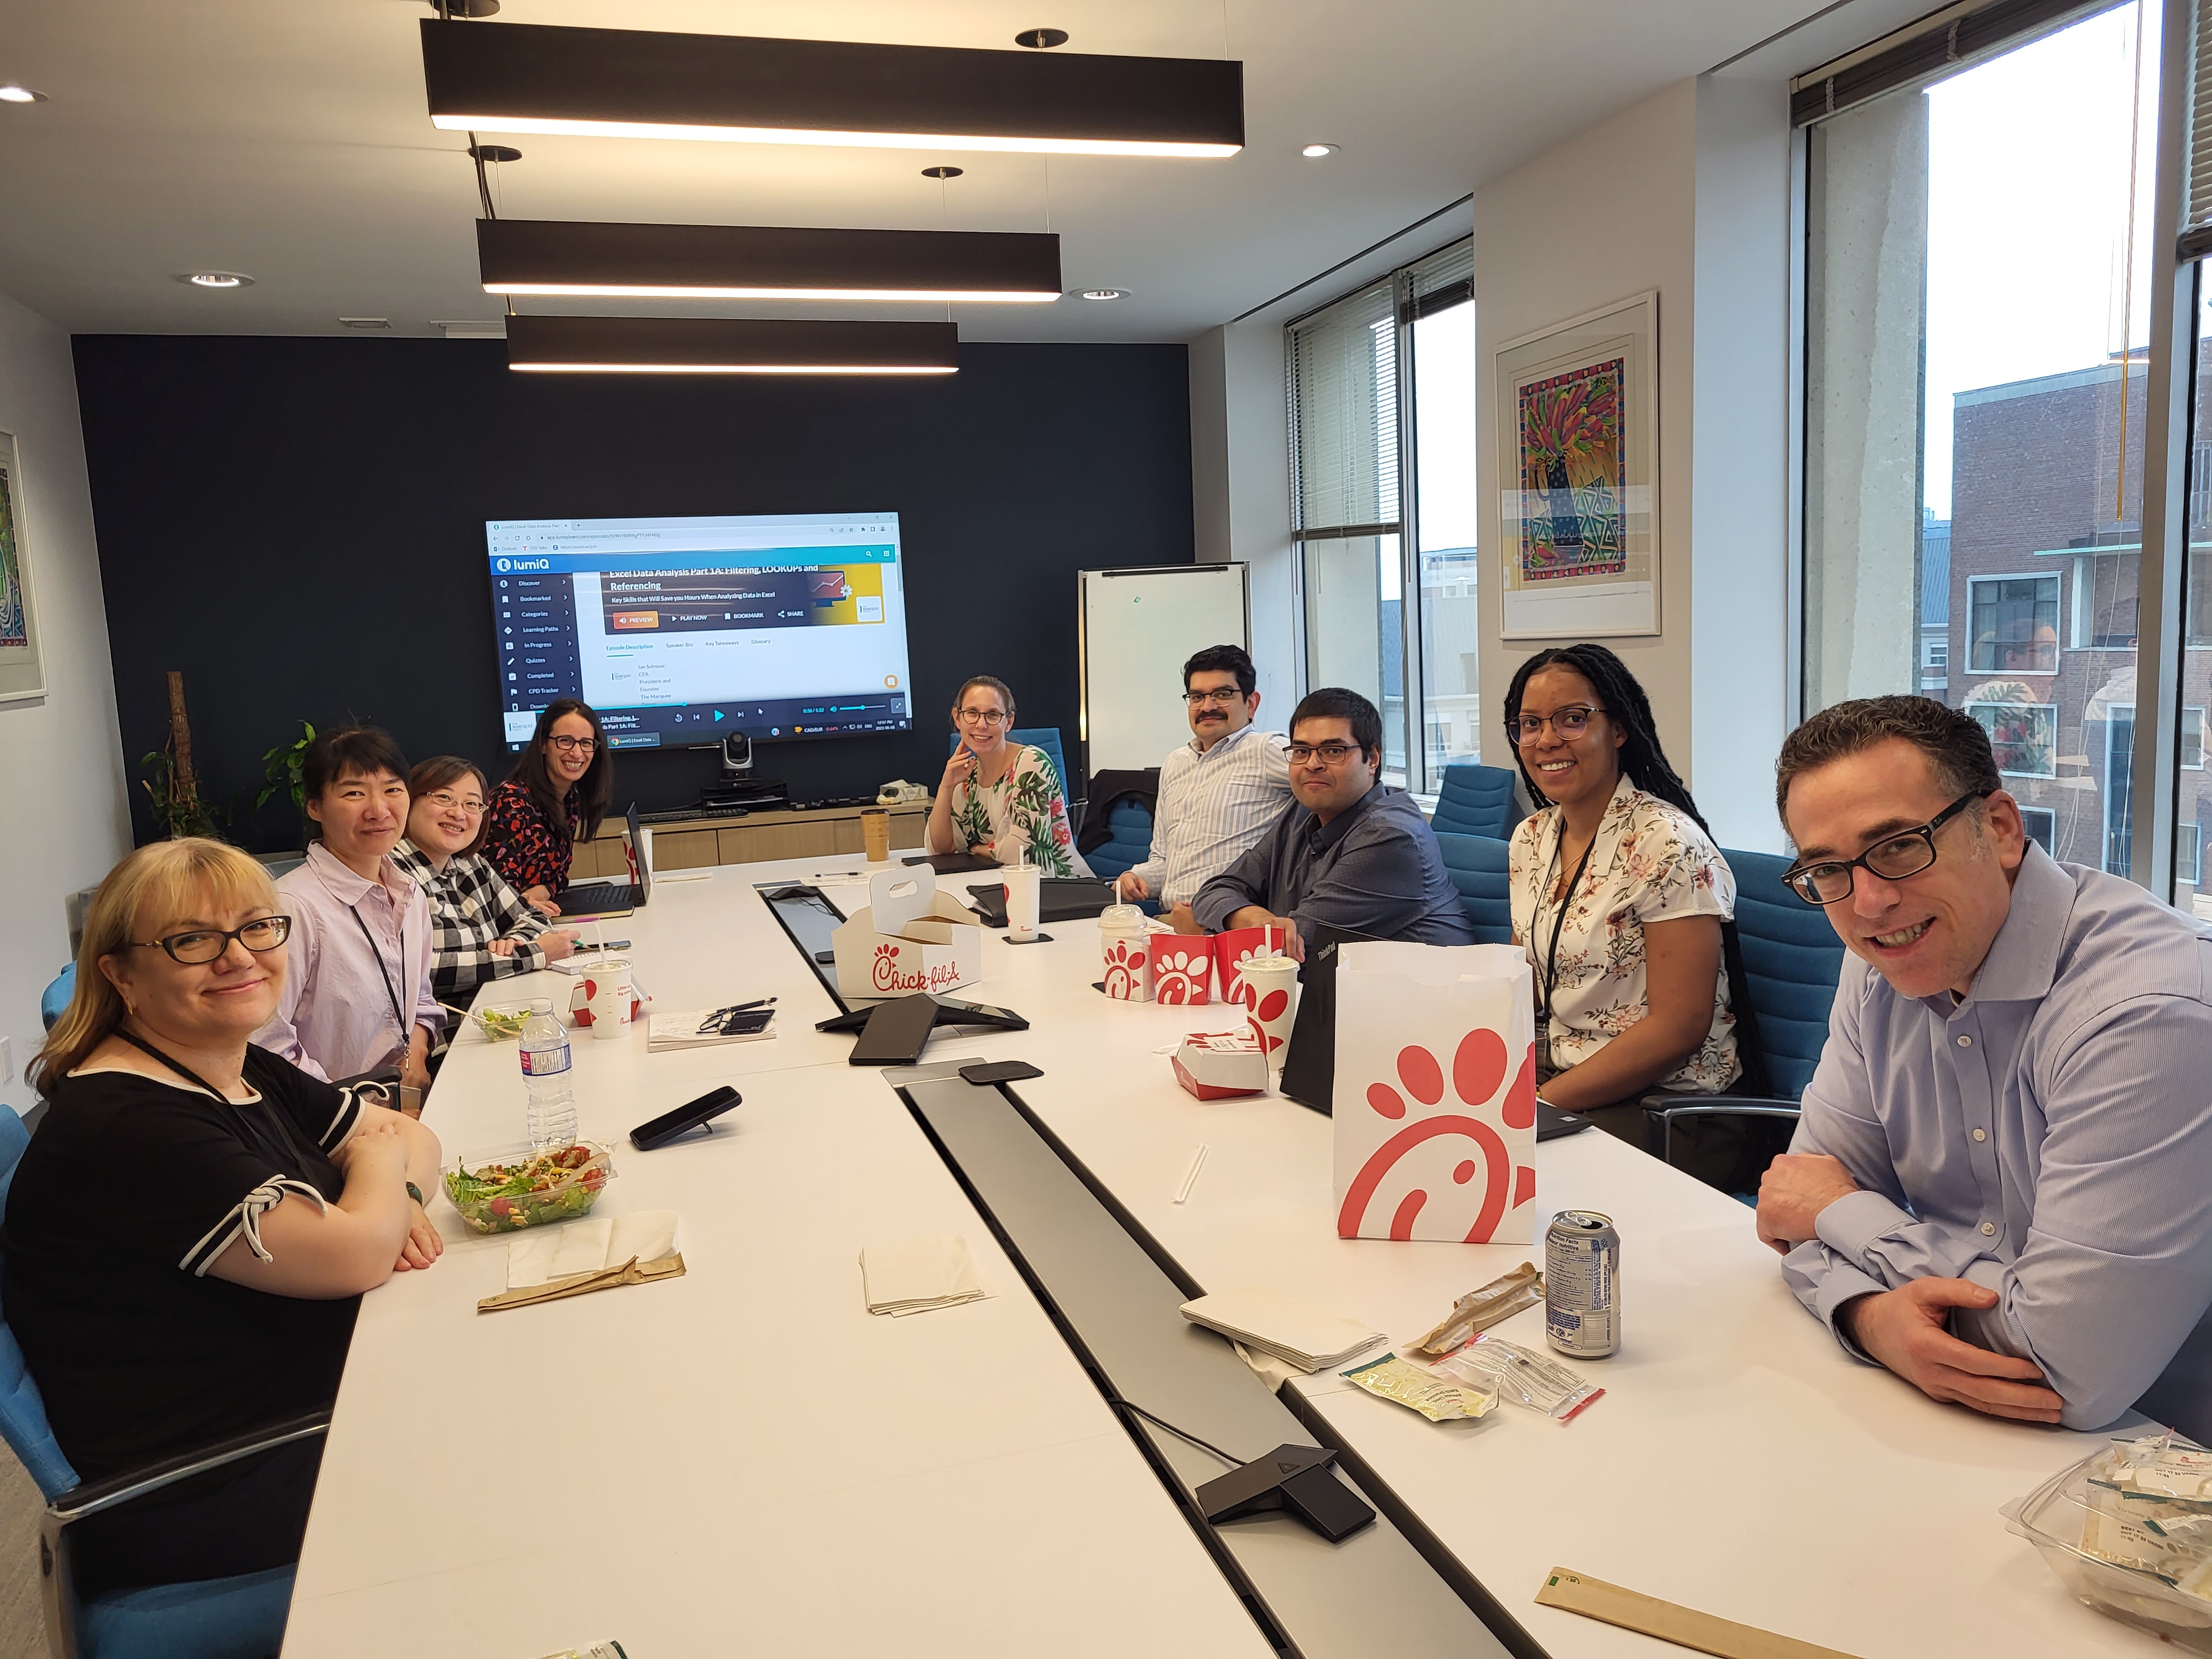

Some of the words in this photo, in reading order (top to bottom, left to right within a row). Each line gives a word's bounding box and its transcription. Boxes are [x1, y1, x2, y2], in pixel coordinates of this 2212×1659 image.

[513, 559, 550, 571] lumiQ
[655, 568, 690, 578] Analysis
[725, 566, 761, 575] Filtering,
[610, 581, 661, 591] Referencing
[1317, 940, 1336, 962] ThinkPad
[873, 955, 960, 992] Chick-fil-A
[1559, 1242, 1579, 1250] nutritive
